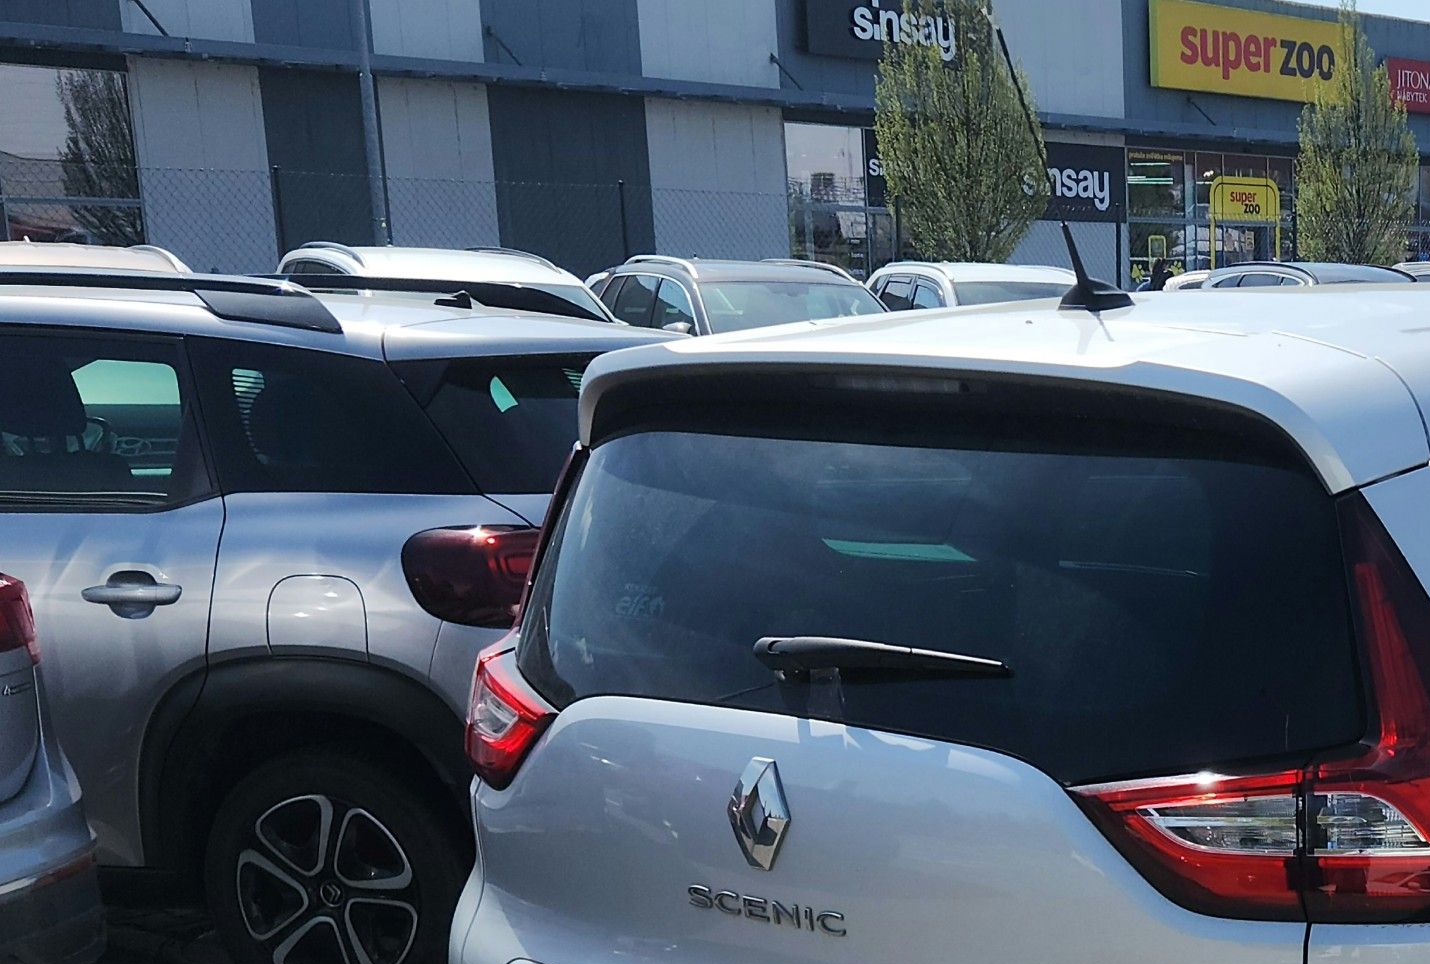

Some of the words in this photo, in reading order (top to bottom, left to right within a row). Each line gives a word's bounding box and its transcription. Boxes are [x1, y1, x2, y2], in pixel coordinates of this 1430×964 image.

[854, 0, 956, 61] sinsay
[1181, 26, 1277, 80] super
[1279, 39, 1335, 81] zoo
[1230, 191, 1257, 205] super
[1243, 203, 1261, 214] zoo
[687, 884, 847, 937] SCENIC
